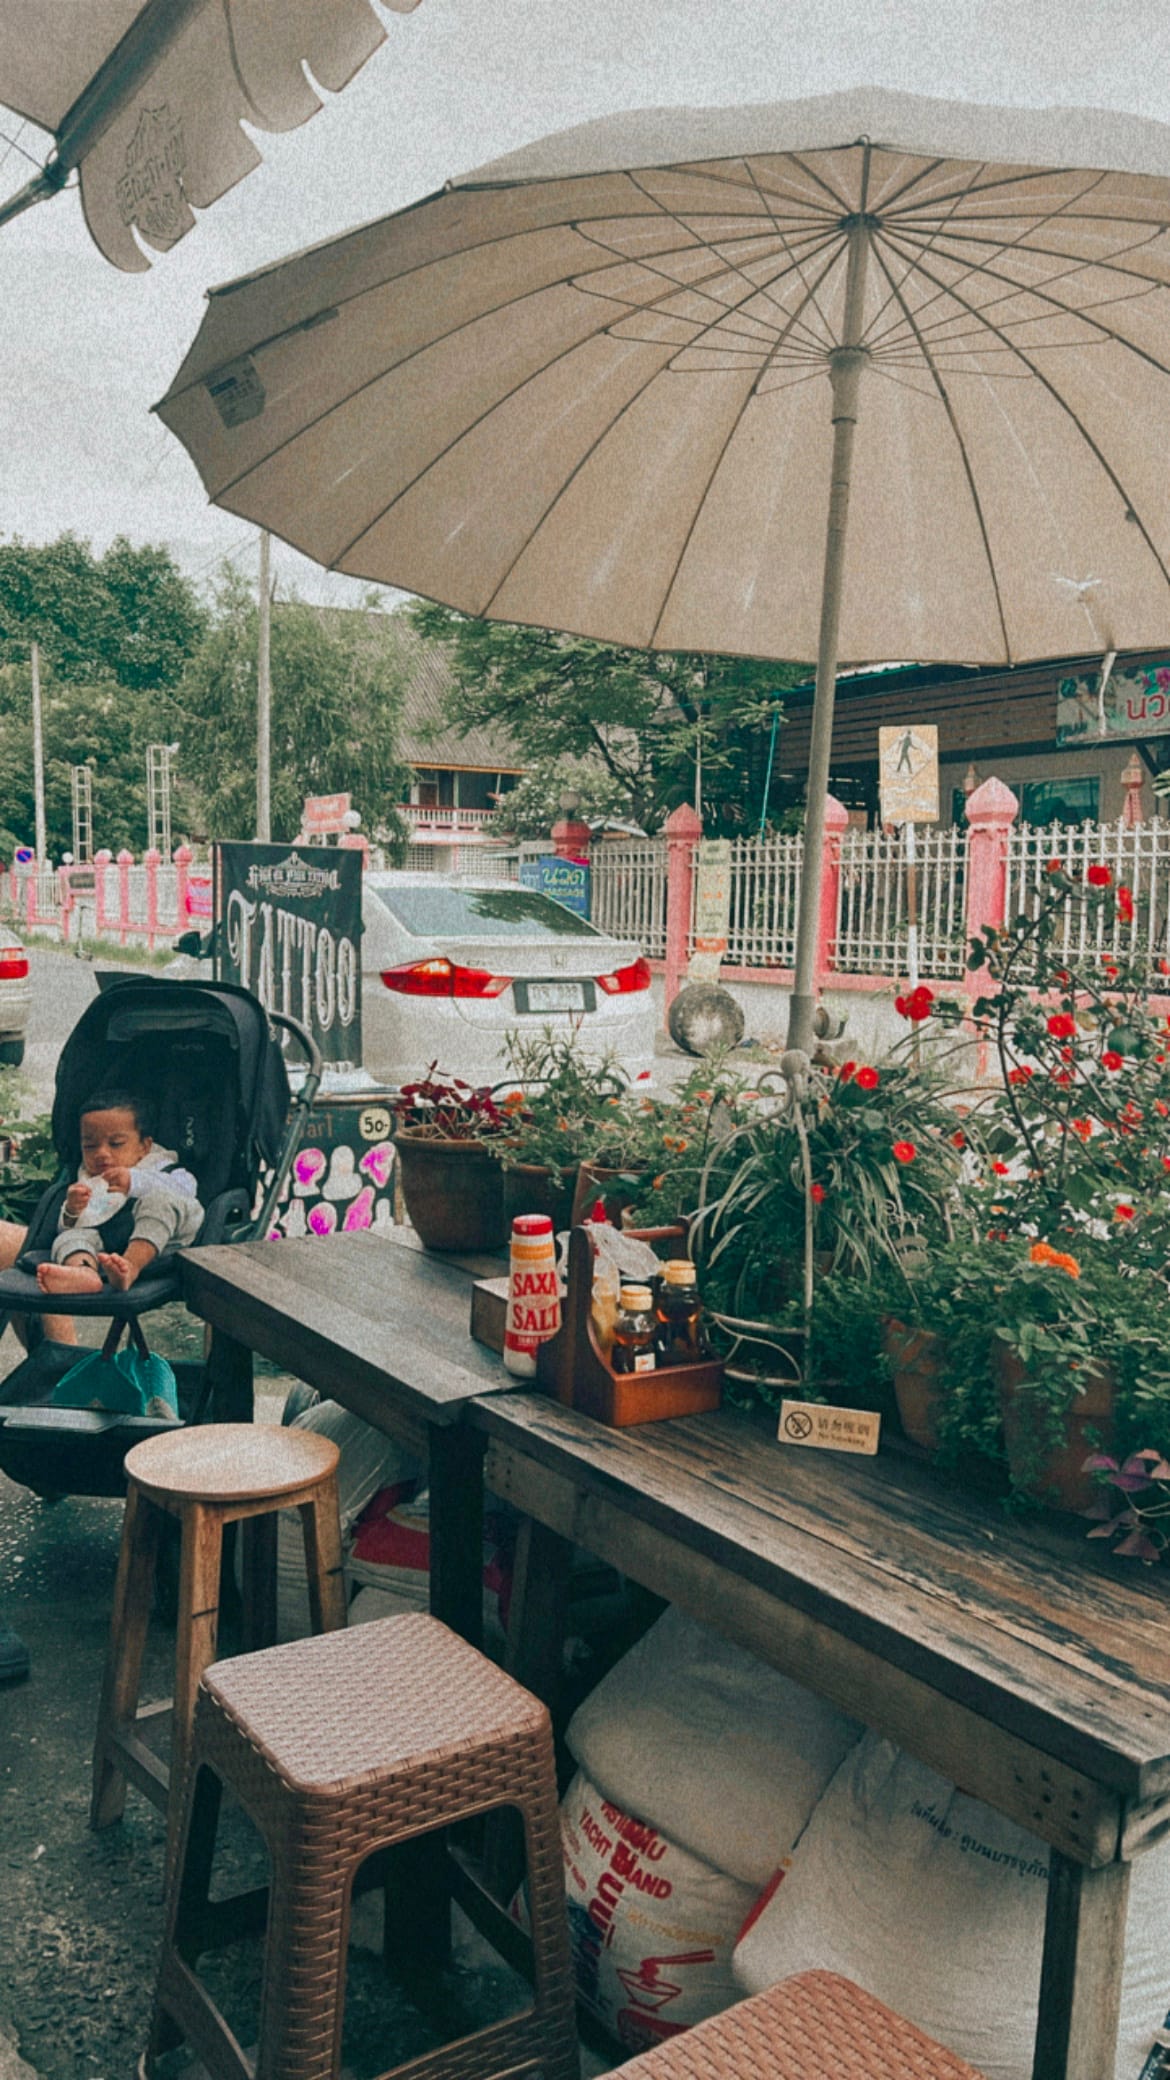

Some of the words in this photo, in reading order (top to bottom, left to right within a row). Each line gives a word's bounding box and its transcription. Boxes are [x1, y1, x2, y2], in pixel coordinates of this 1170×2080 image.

[1126, 693, 1170, 720] นว
[227, 889, 356, 1048] TATTOO
[512, 1271, 558, 1298] SAXA
[512, 1302, 558, 1331] SALT
[579, 1807, 613, 1858] YACHT
